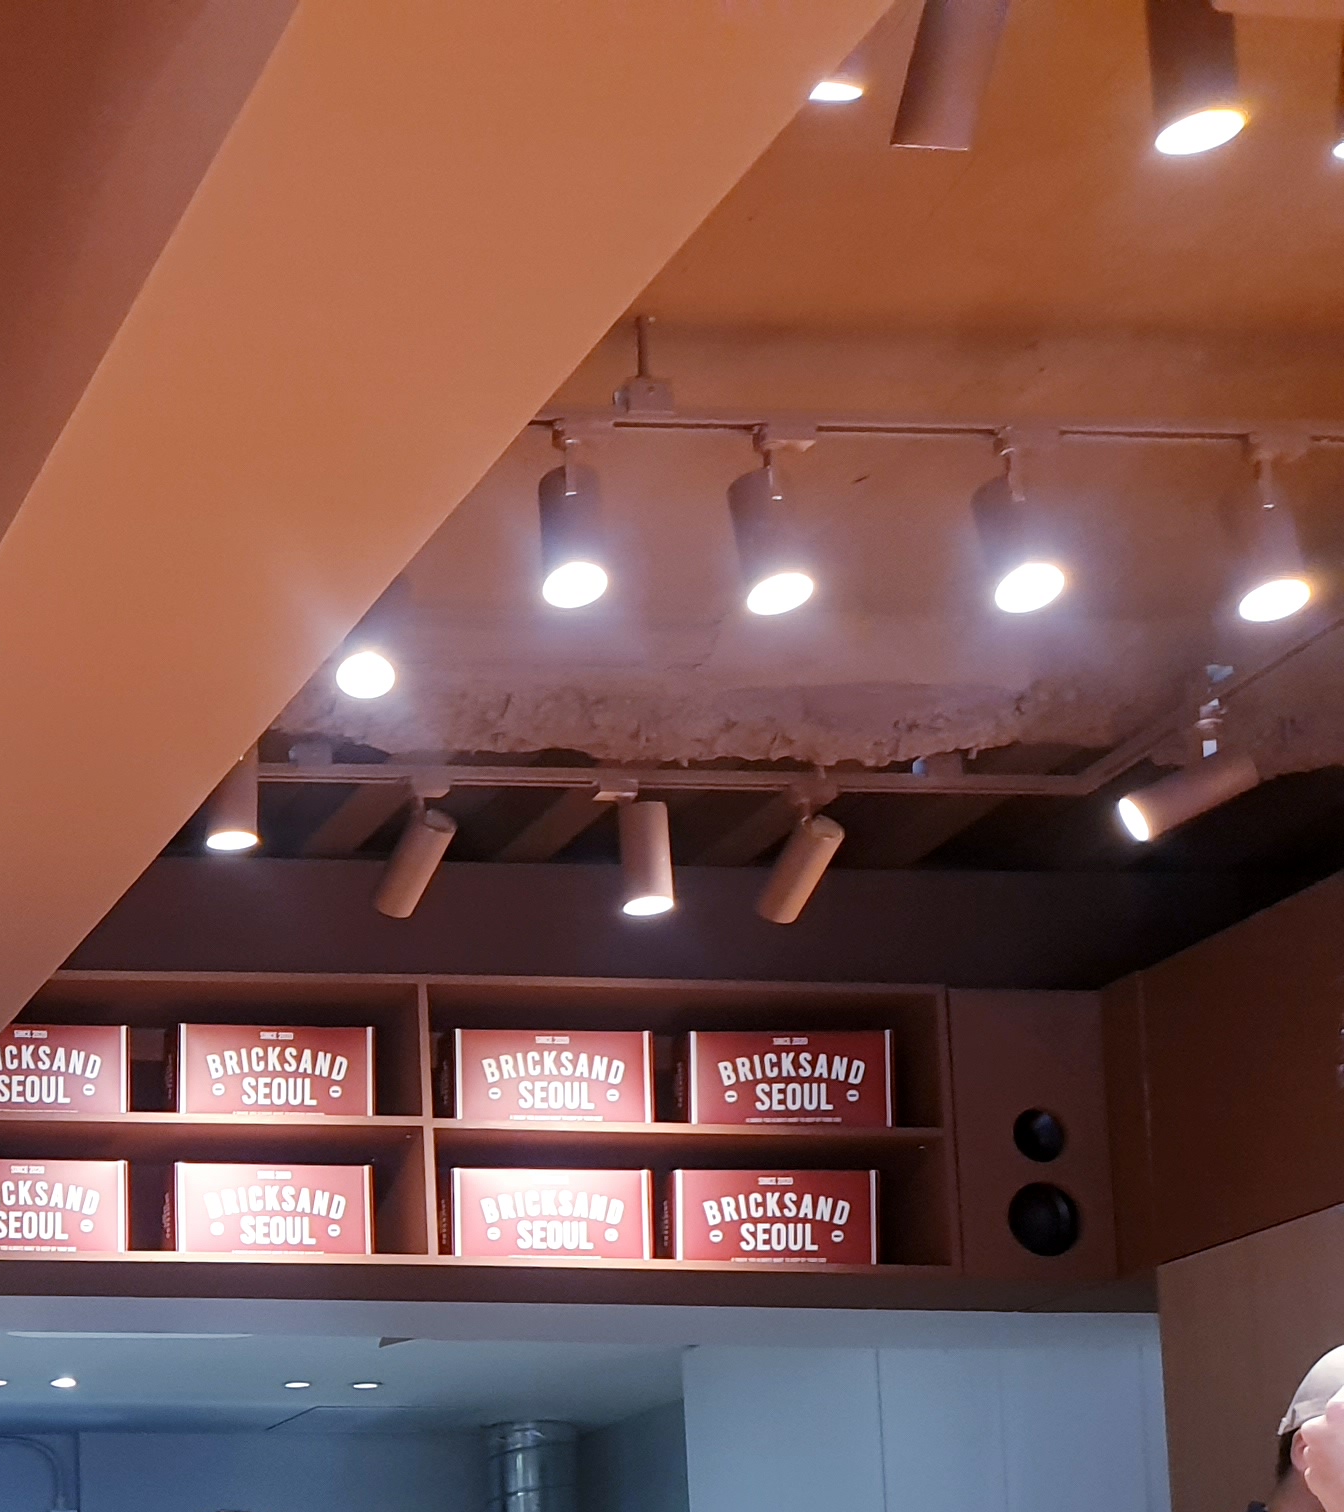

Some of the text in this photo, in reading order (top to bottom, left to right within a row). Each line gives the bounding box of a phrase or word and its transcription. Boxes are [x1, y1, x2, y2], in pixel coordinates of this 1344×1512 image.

[206, 1046, 348, 1081] BRICKSAND
[481, 1051, 626, 1085] BRICKSAND
[717, 1052, 865, 1086] BRICKSAND
[241, 1076, 317, 1106] SEOUL
[518, 1080, 595, 1110] SEOUL
[755, 1082, 833, 1111] SEOUL
[203, 1185, 347, 1220] BRICKSAND
[480, 1189, 625, 1225] BRICKSAND
[702, 1191, 850, 1227] BRICKSAND
[239, 1214, 316, 1245] SEOUL
[516, 1219, 593, 1250] SEOUL
[739, 1221, 818, 1252] SEOUL
